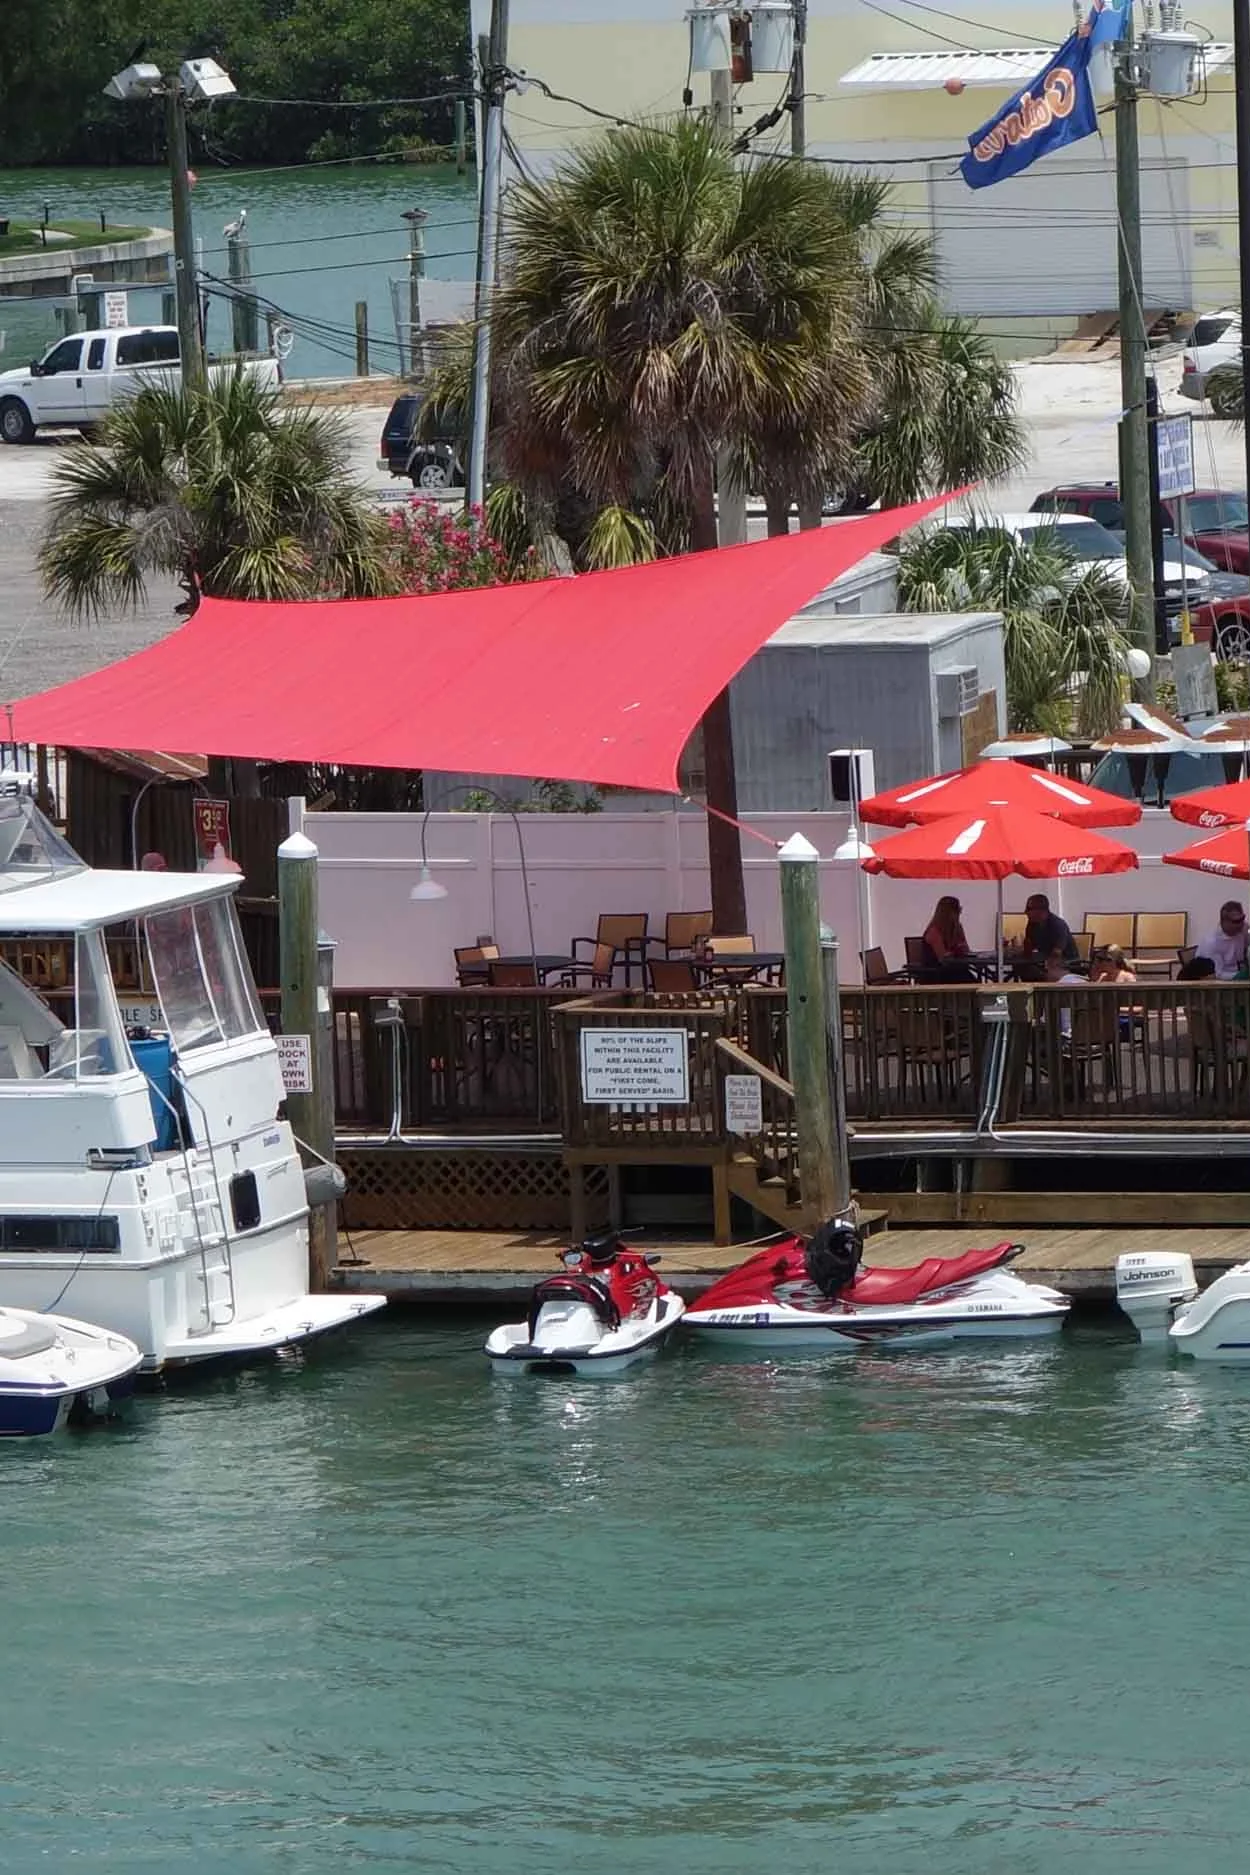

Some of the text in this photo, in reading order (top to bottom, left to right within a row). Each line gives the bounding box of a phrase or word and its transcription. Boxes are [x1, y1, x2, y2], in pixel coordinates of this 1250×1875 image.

[1058, 857, 1092, 875] Coca-Cola
[282, 1040, 302, 1048] USE
[282, 1070, 304, 1078] OWN
[1124, 1269, 1175, 1281] Johnson
[975, 1304, 1002, 1312] YAMAHA
